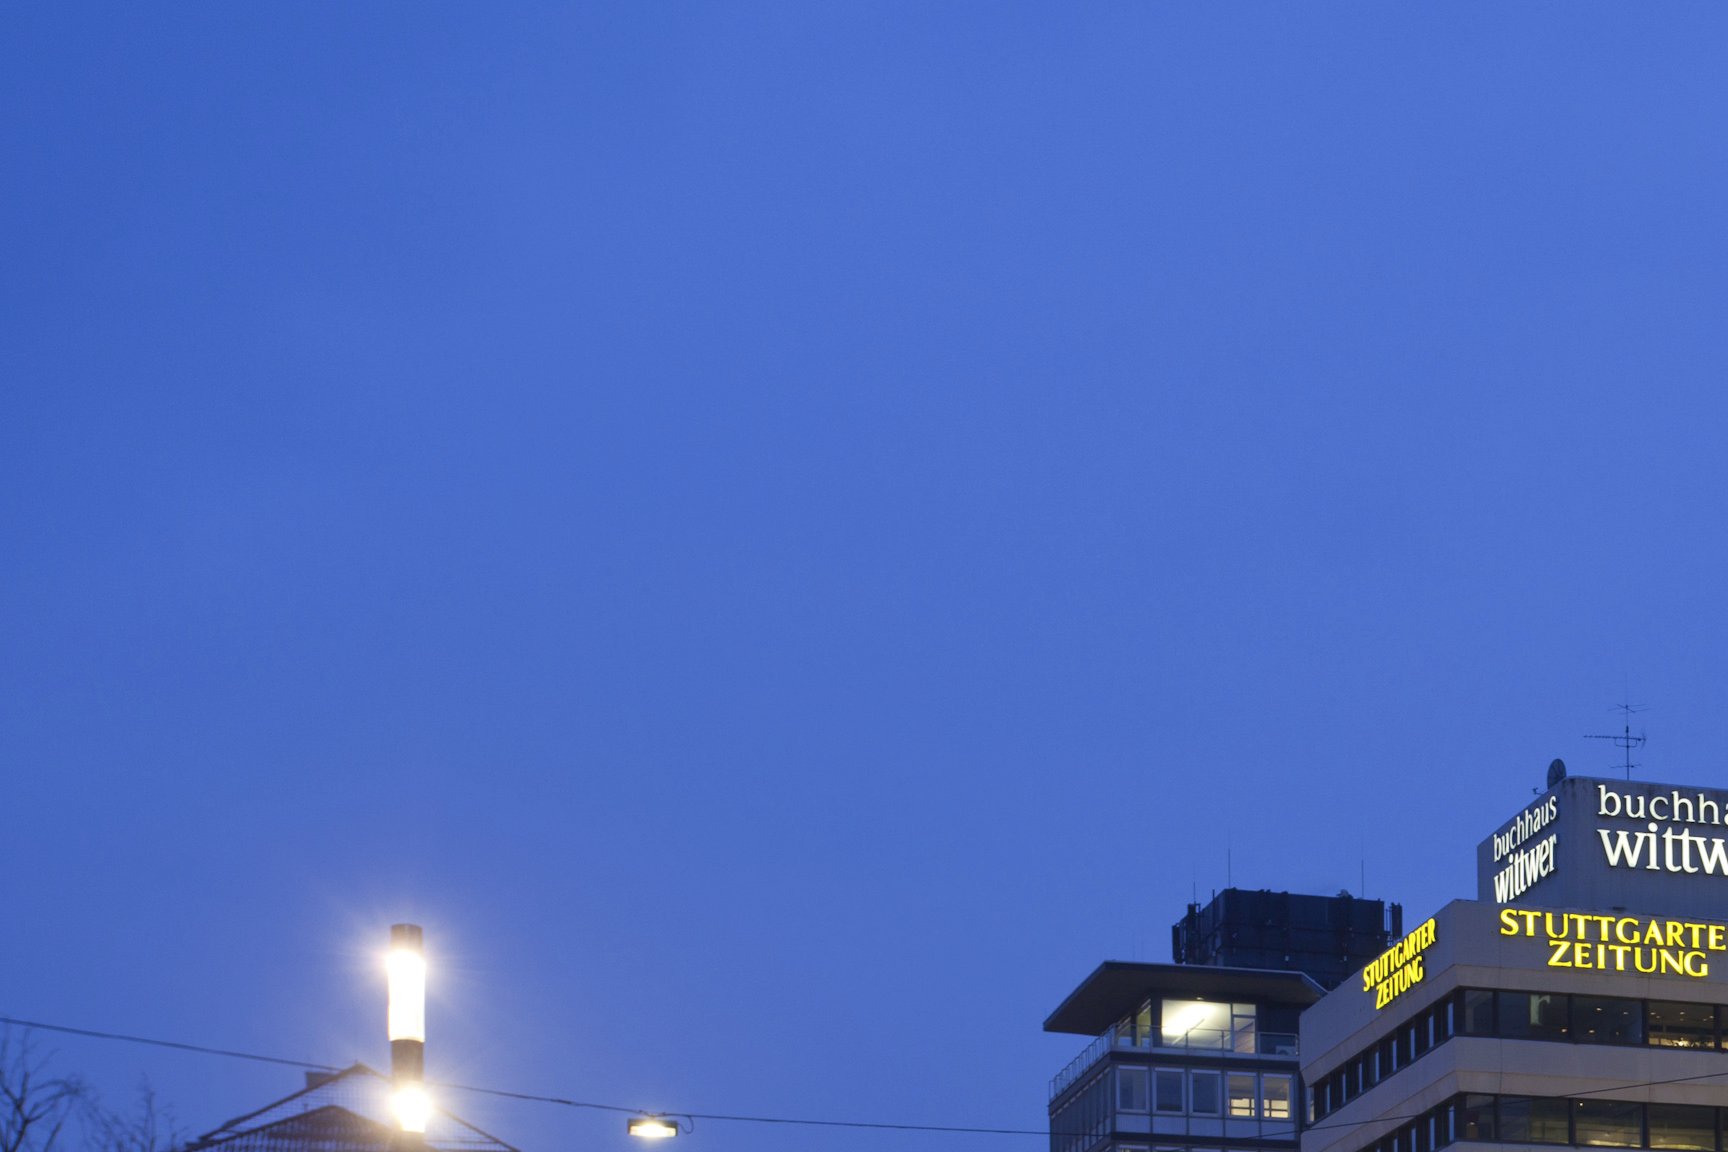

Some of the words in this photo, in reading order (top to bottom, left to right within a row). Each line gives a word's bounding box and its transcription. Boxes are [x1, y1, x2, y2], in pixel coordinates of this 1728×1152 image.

[1493, 794, 1558, 862] buchhaus
[1493, 833, 1558, 904] wittwer
[1362, 917, 1437, 992] STUTTGARTER
[1375, 955, 1424, 1010] ZEITUNG
[1547, 940, 1709, 977] ZEITUNG
